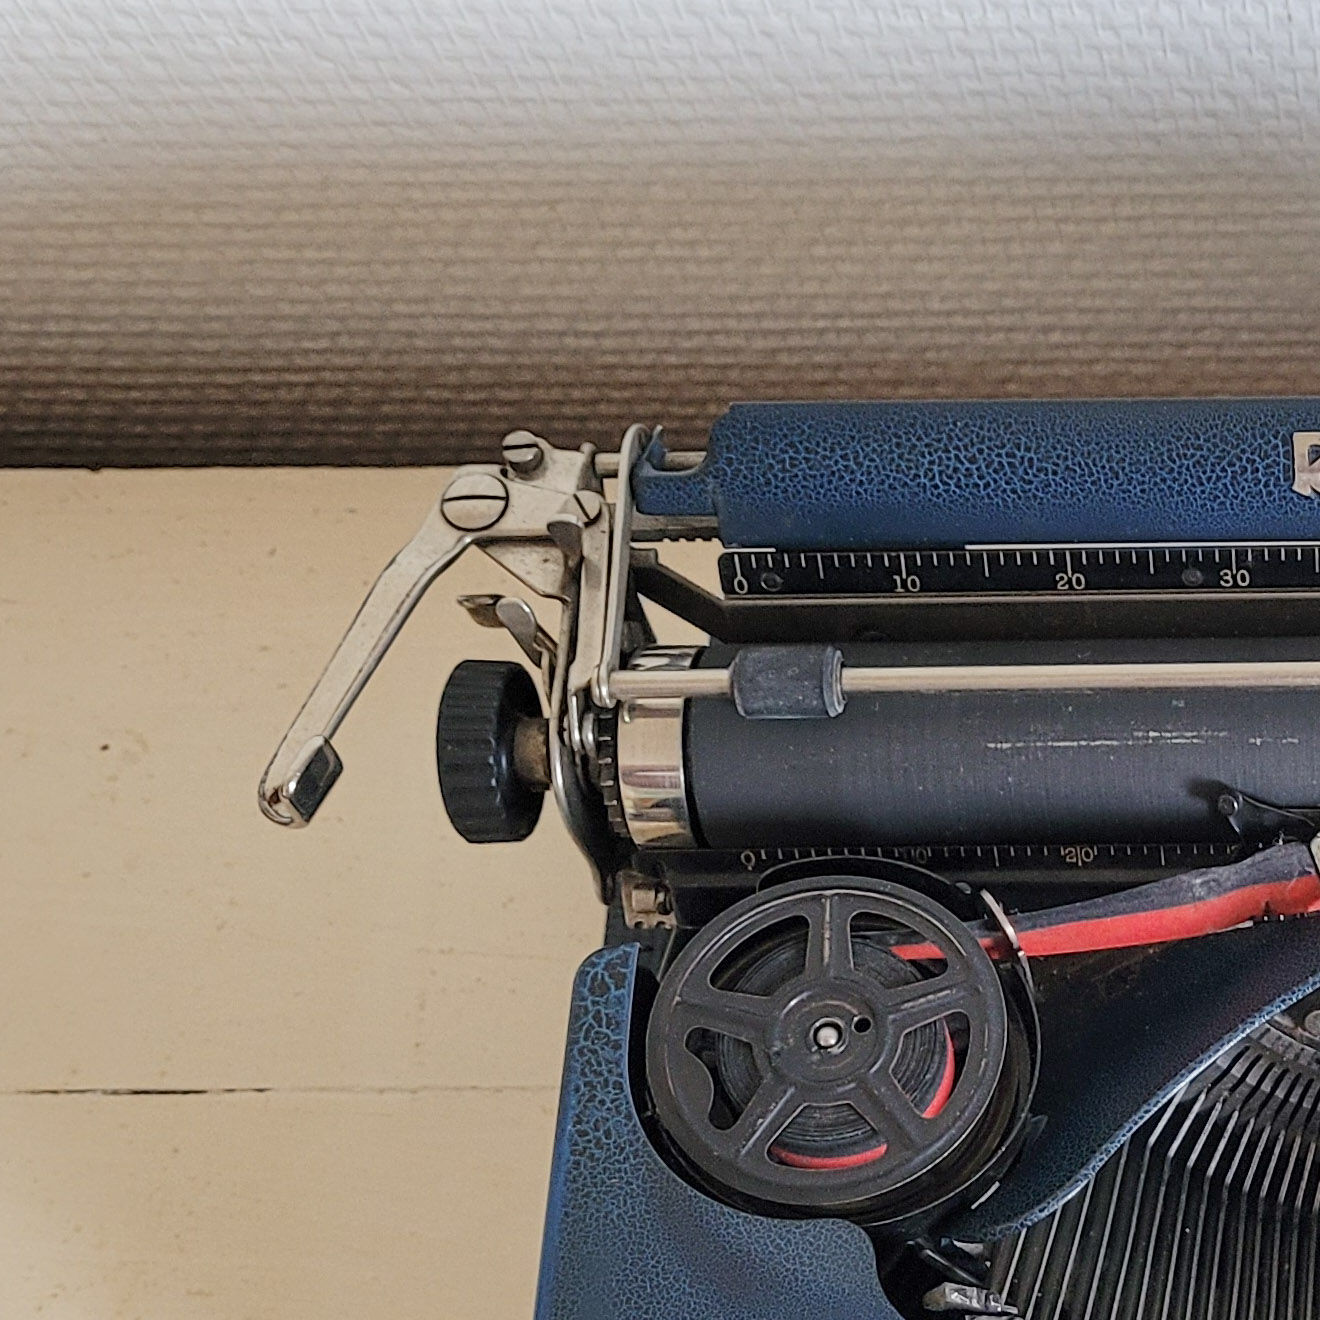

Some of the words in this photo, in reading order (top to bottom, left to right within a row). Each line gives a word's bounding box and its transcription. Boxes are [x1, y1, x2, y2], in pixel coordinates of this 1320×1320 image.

[733, 576, 749, 595] 0
[893, 574, 921, 593] 10
[1055, 572, 1086, 591] 20
[1219, 569, 1250, 588] 30
